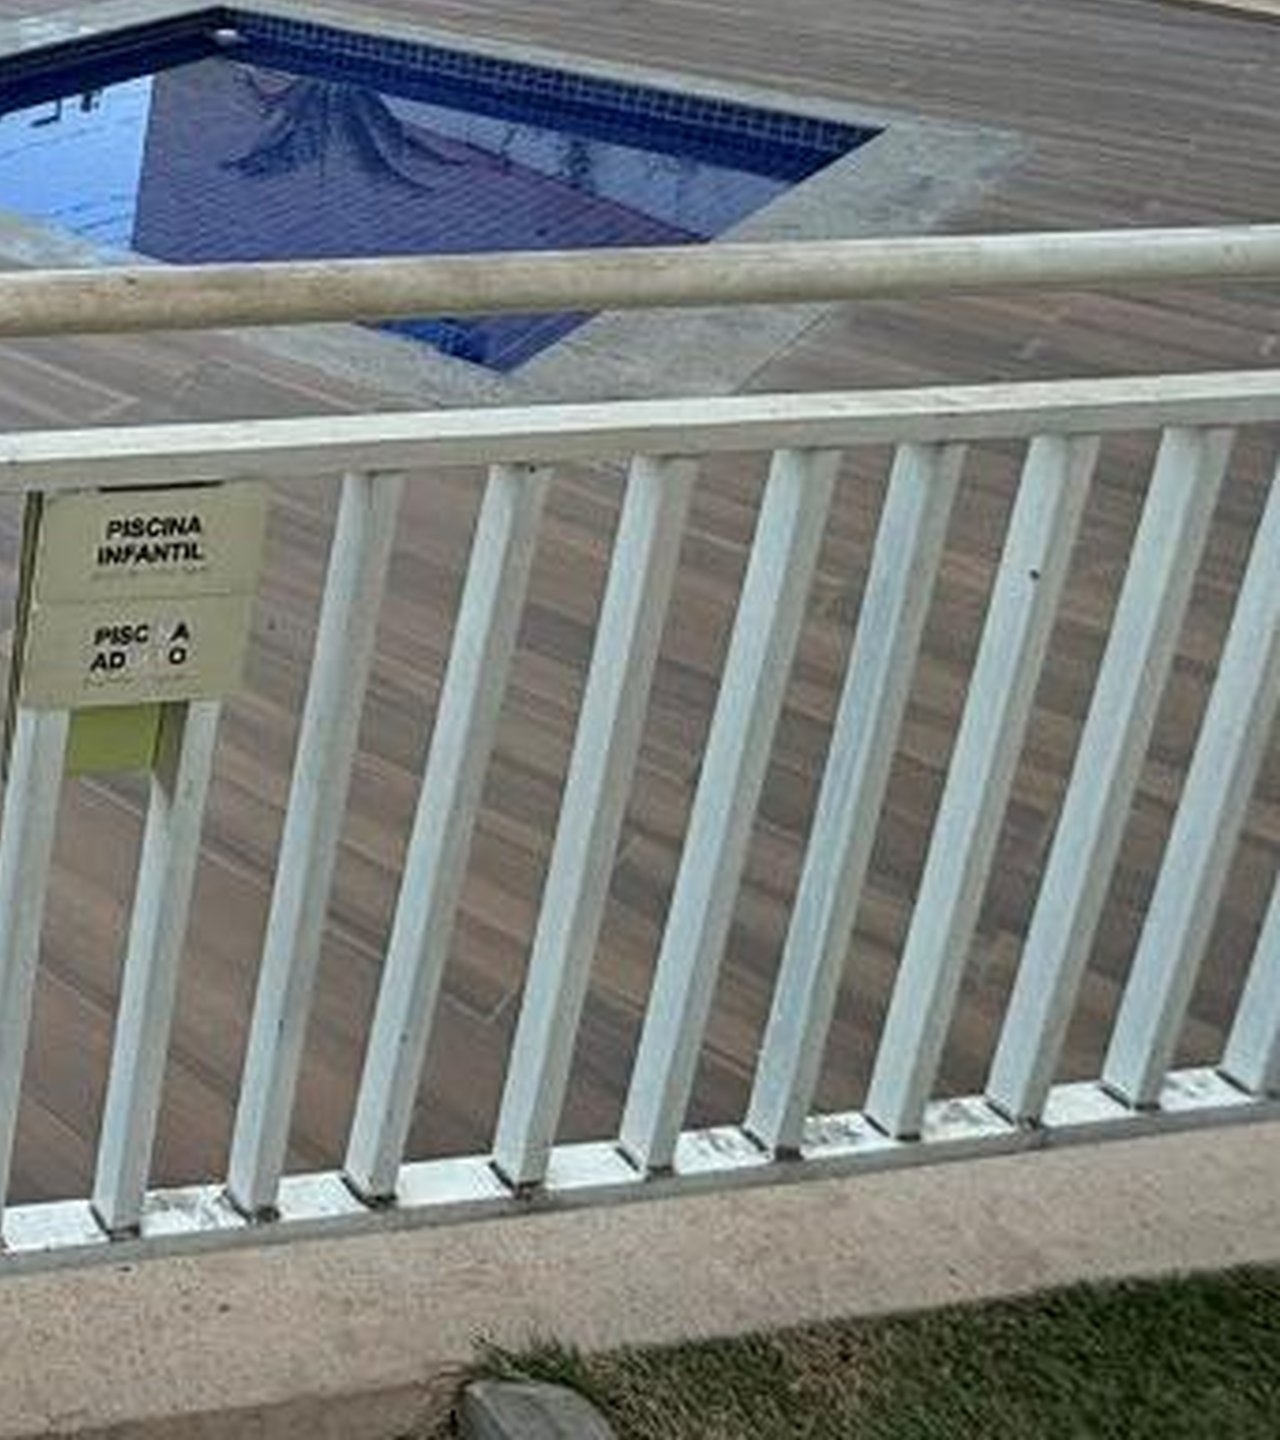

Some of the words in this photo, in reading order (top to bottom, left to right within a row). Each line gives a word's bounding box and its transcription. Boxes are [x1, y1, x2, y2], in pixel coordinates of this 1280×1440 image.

[106, 515, 202, 540] PISCINA
[97, 543, 205, 565] INFANTIL
[93, 622, 190, 646] PISCA
